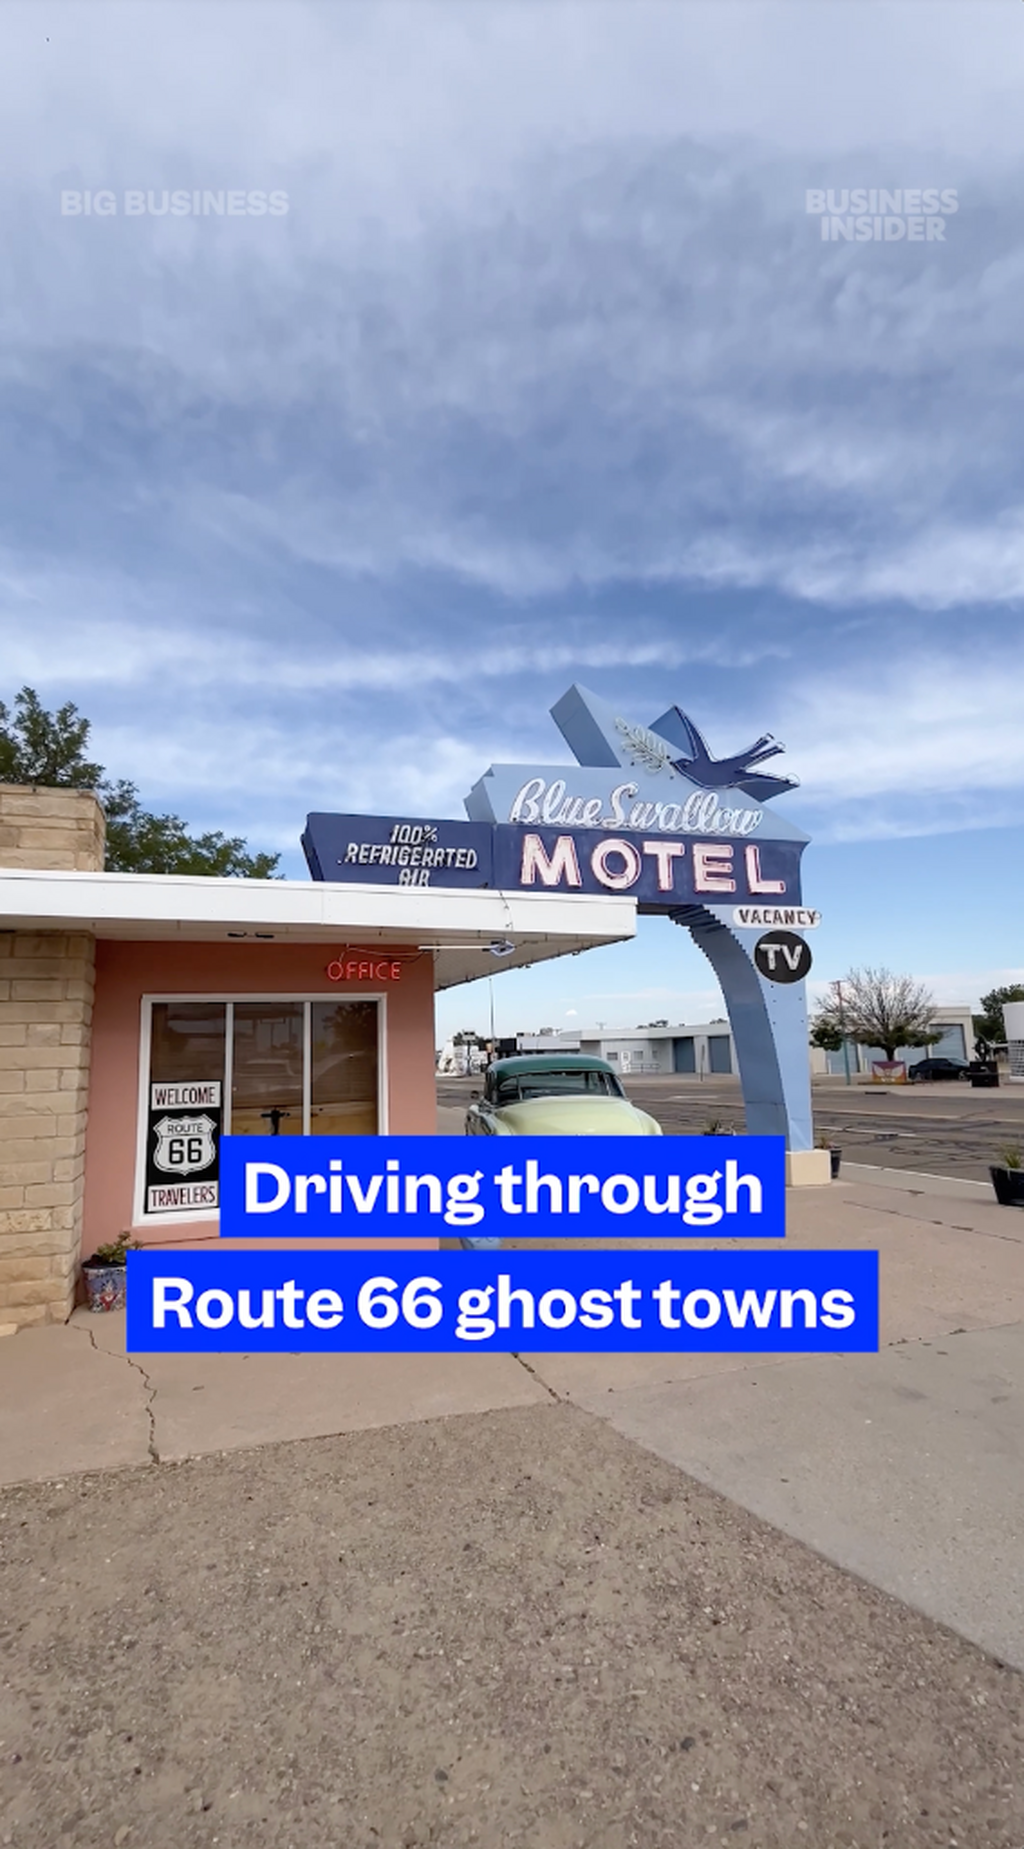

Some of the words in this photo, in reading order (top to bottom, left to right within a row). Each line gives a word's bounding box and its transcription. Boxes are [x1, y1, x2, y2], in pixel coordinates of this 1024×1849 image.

[509, 777, 602, 827] Blue
[601, 781, 764, 836] Swallow
[390, 824, 438, 845] 100%
[344, 842, 478, 869] REFRIGERATED
[519, 833, 787, 894] MOTEL
[399, 868, 430, 887] AIR
[738, 908, 817, 925] VACANCY
[758, 943, 803, 971] TV
[326, 960, 402, 981] OFFICE
[154, 1086, 216, 1106] WELCOME
[167, 1122, 204, 1134] ROUTE
[169, 1138, 202, 1164] 66
[151, 1185, 216, 1207] TRAVELERS
